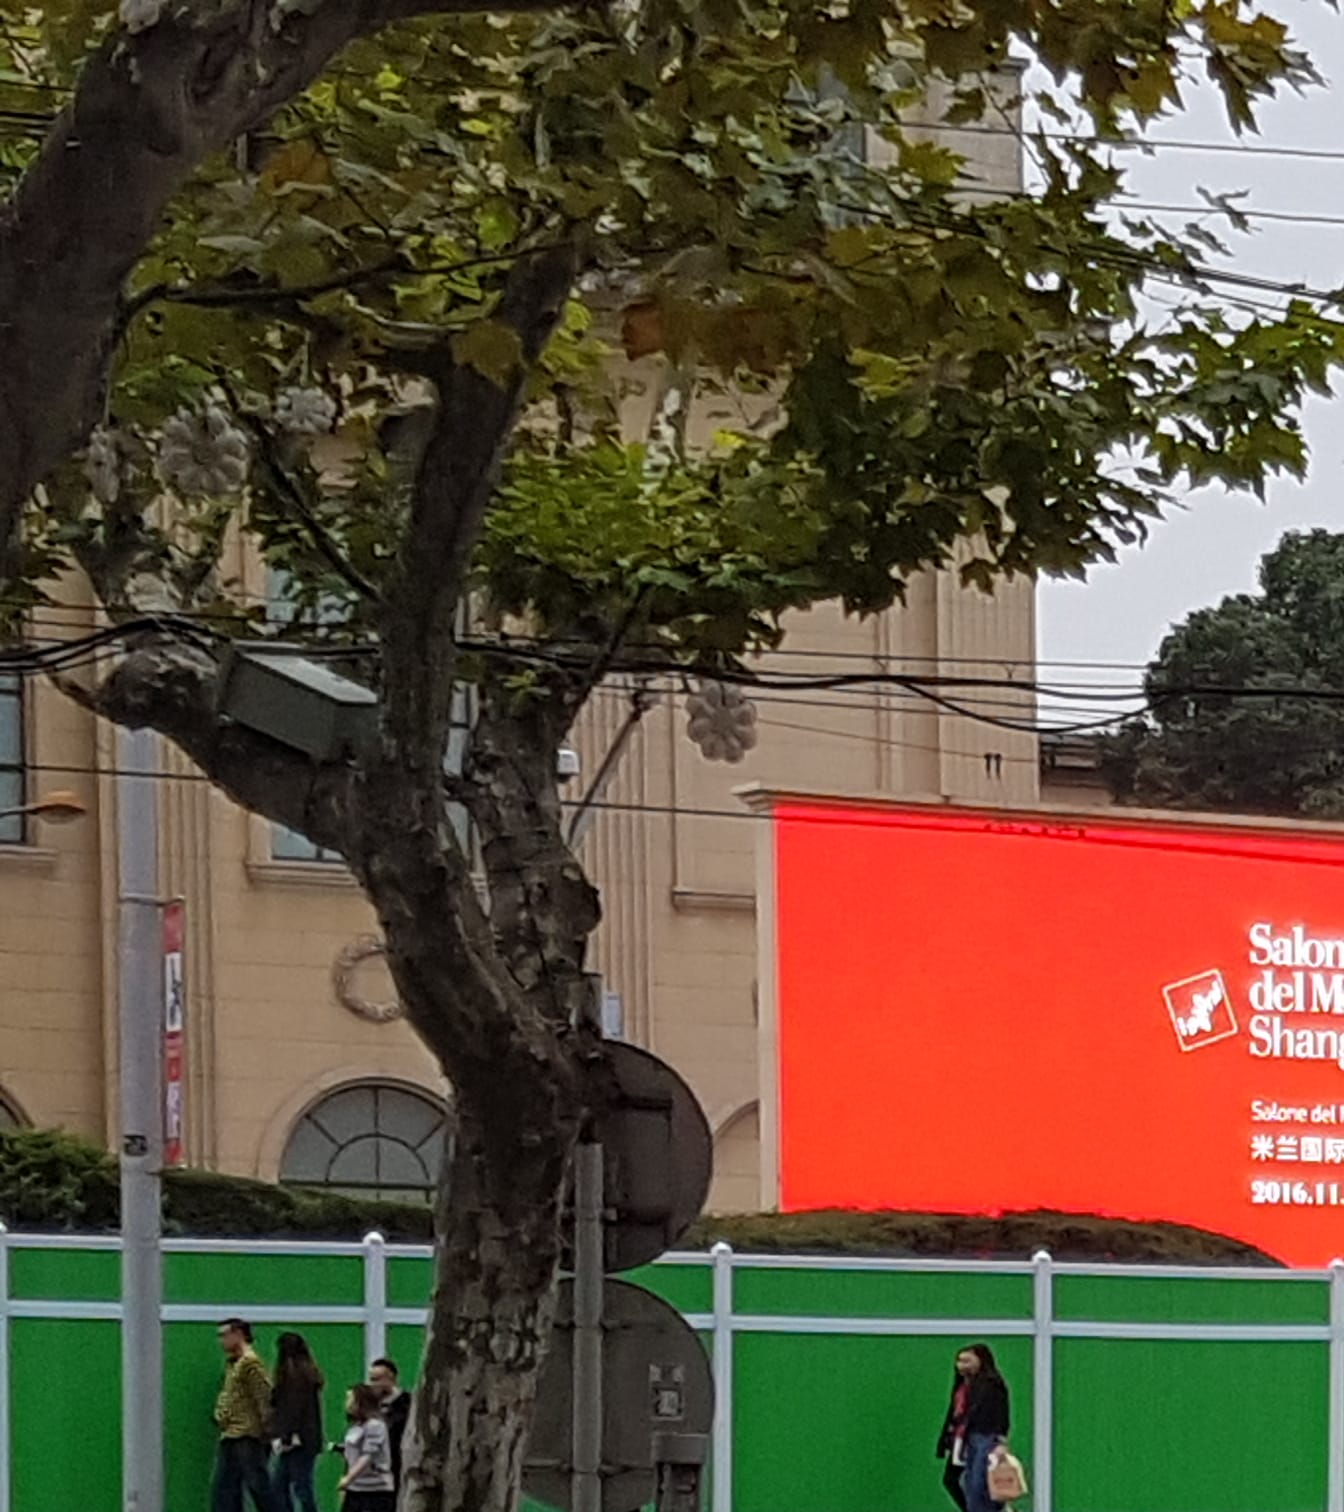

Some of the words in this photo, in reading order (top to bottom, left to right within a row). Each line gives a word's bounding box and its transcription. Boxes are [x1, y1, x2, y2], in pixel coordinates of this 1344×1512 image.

[1249, 971, 1304, 1012] del
[1251, 1100, 1307, 1123] Salone
[1311, 1103, 1335, 1124] del
